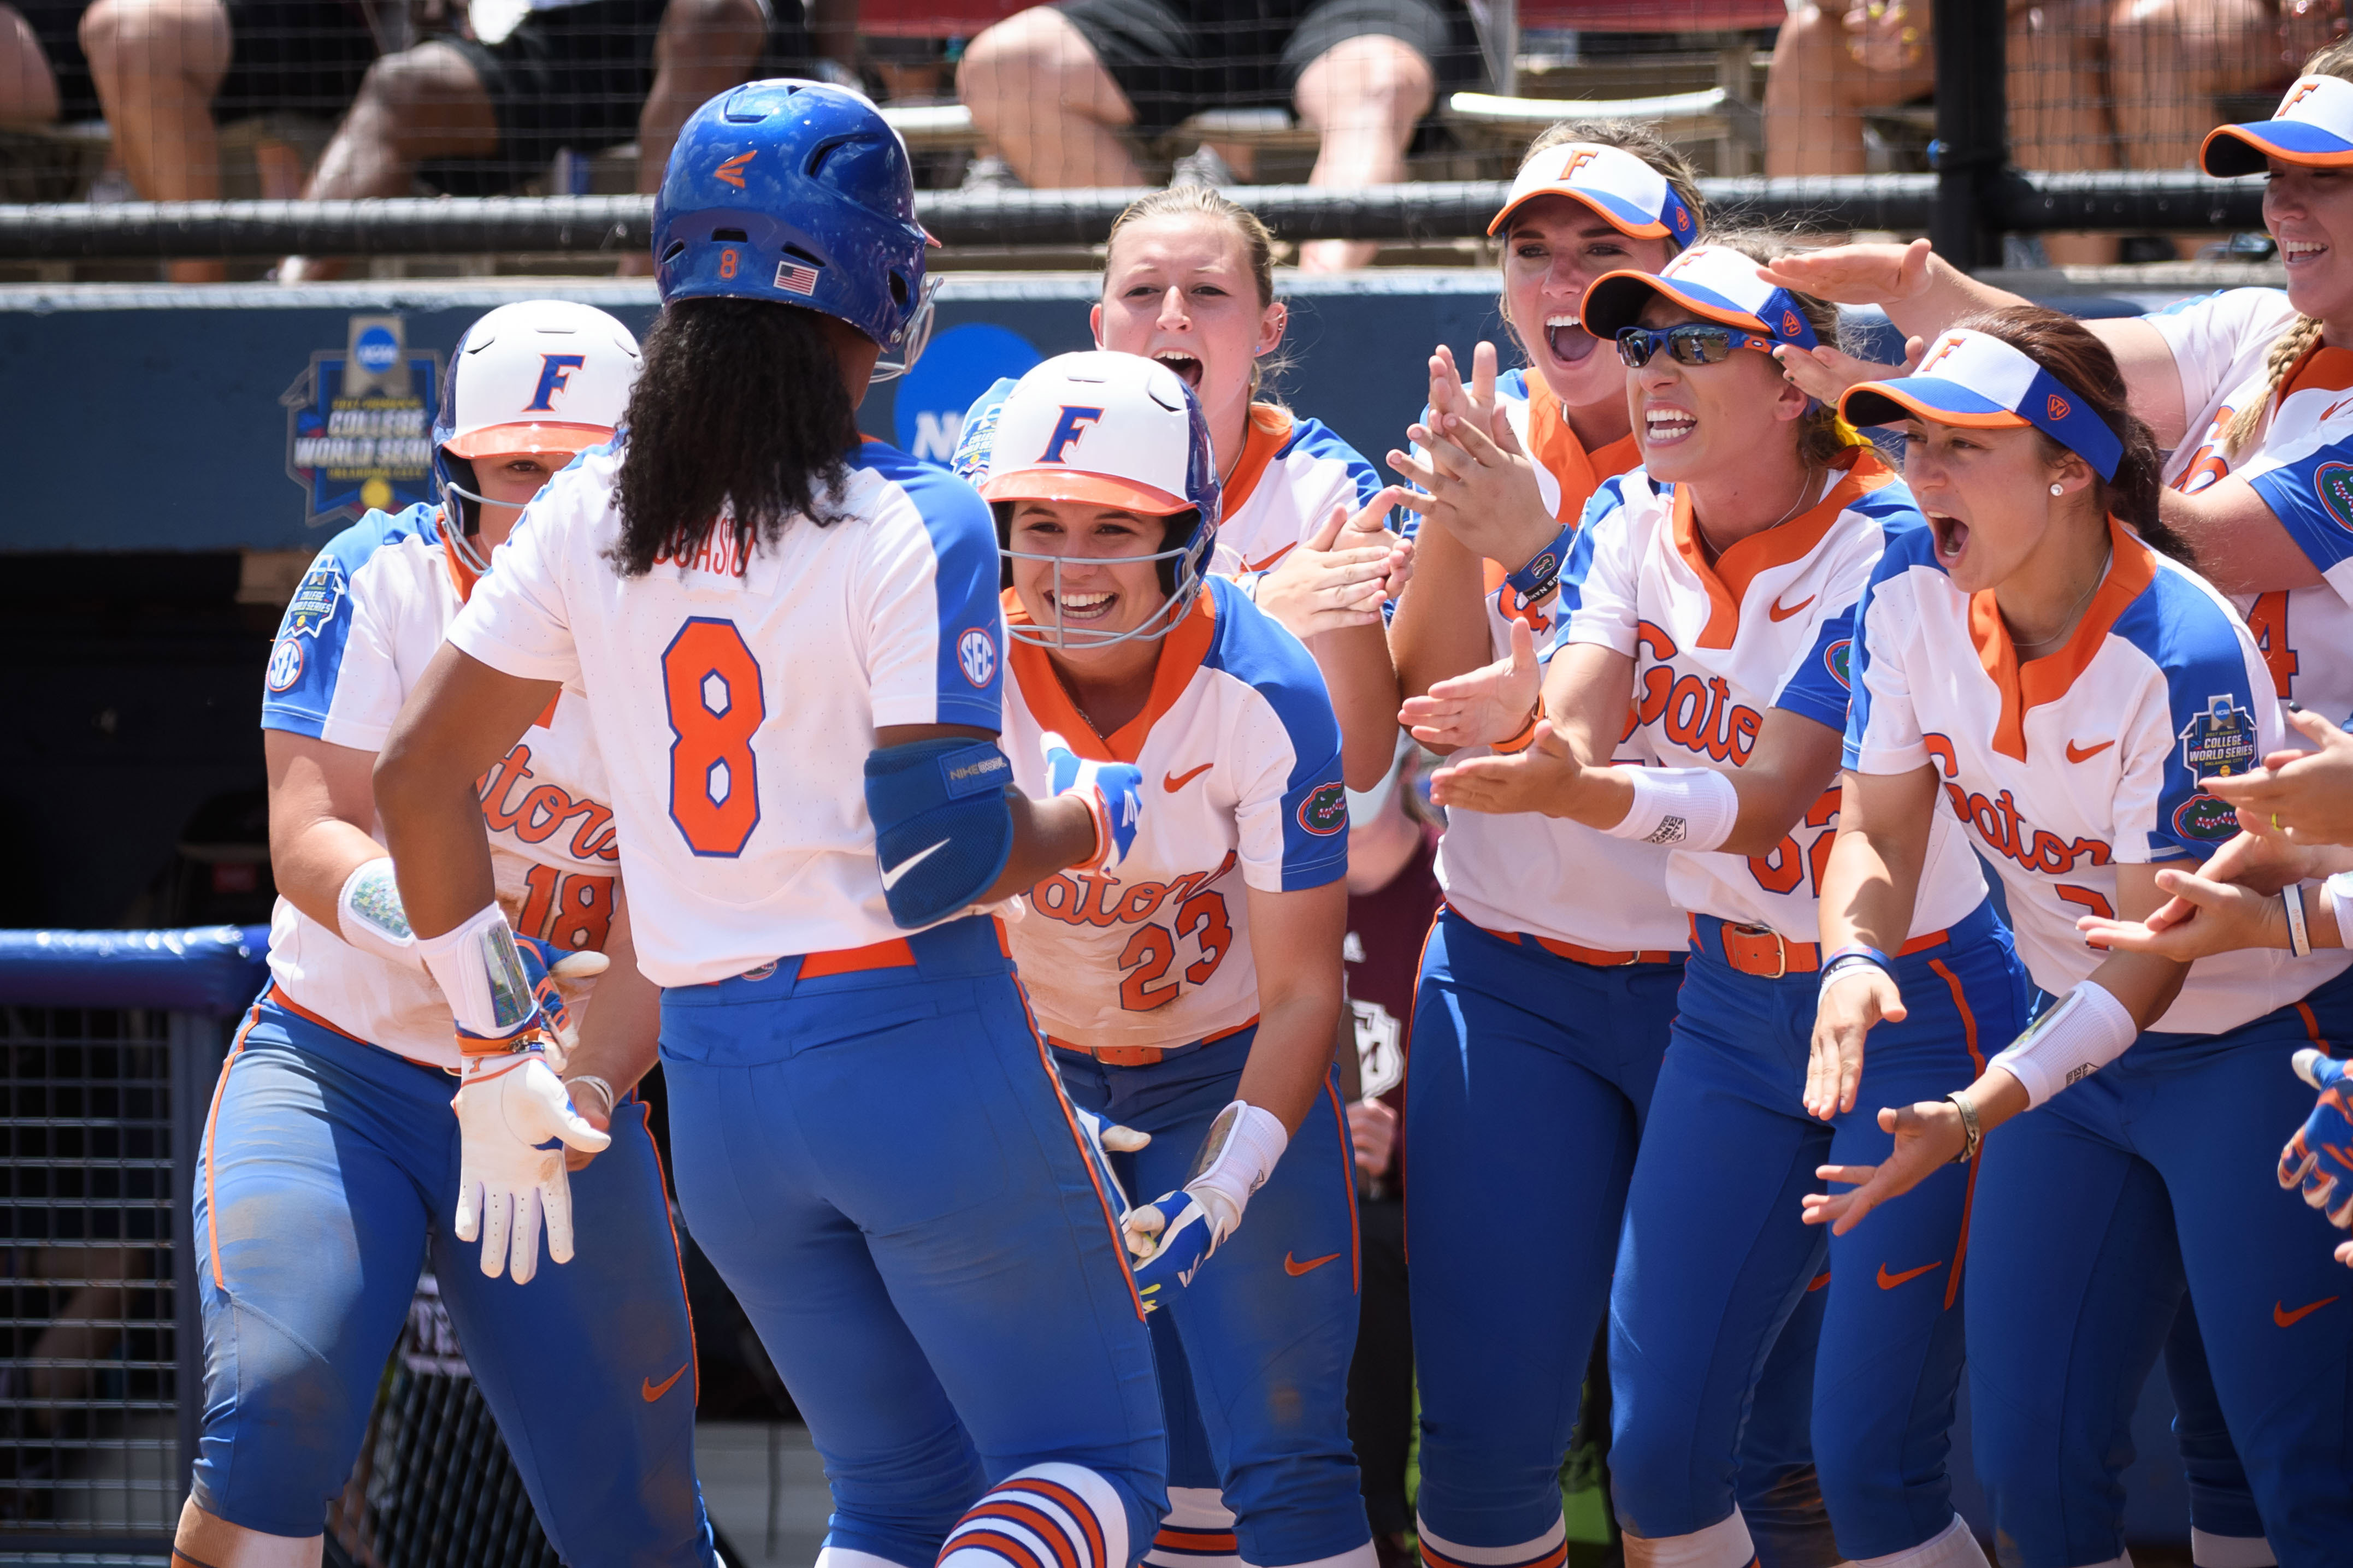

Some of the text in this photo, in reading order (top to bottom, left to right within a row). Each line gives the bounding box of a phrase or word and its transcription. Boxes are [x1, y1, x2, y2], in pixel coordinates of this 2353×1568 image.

[2277, 84, 2320, 117] F
[1556, 150, 1599, 181] F
[719, 249, 739, 280] 8
[1666, 251, 1709, 277] F
[1922, 338, 1966, 371] F
[521, 353, 586, 412] F
[1033, 405, 1105, 464] F
[270, 642, 300, 687] SEC
[962, 633, 993, 683] SEC
[1638, 619, 1764, 767] Gato
[661, 616, 766, 858] 8
[2190, 744, 2254, 762] WORLD SERIES
[2204, 735, 2242, 749] COLLEGE
[517, 863, 615, 952] 18
[1117, 889, 1232, 1012] 23
